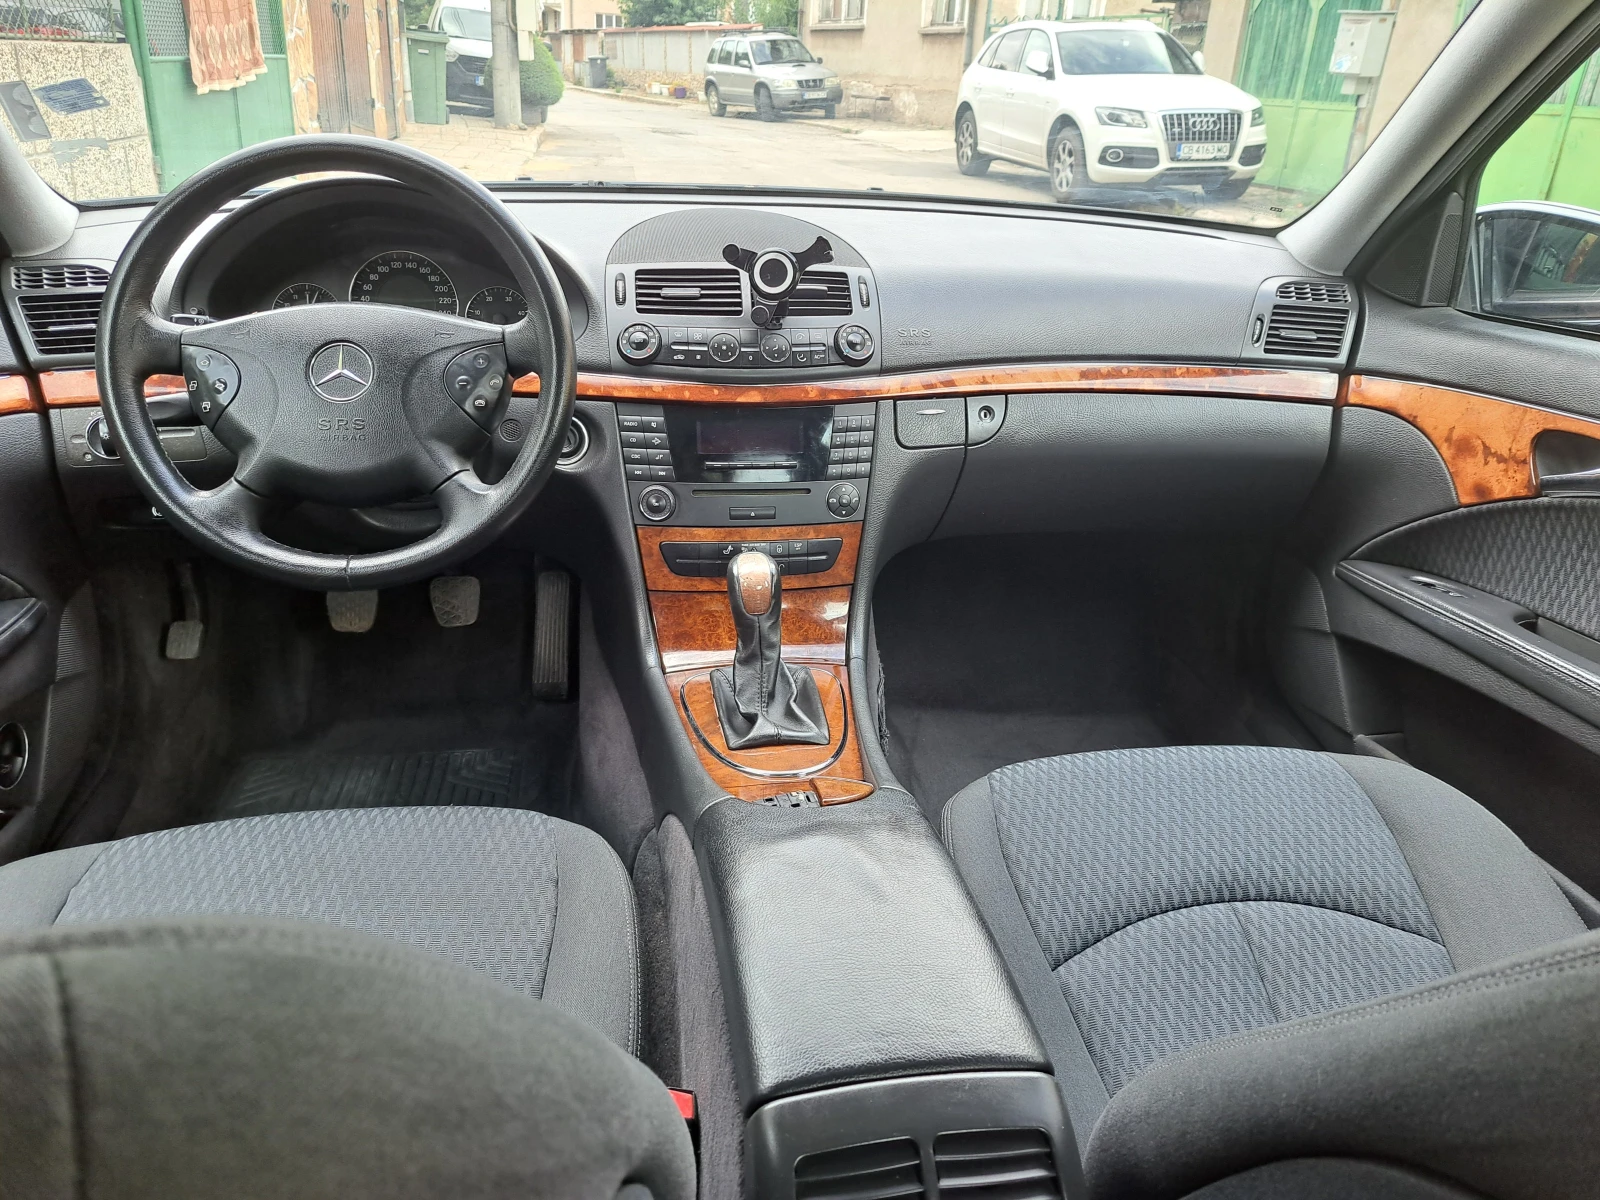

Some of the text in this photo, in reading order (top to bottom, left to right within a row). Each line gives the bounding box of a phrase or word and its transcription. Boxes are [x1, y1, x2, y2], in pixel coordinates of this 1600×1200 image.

[1196, 145, 1216, 154] 4163
[898, 328, 931, 337] SRS
[318, 418, 365, 430] SRS
